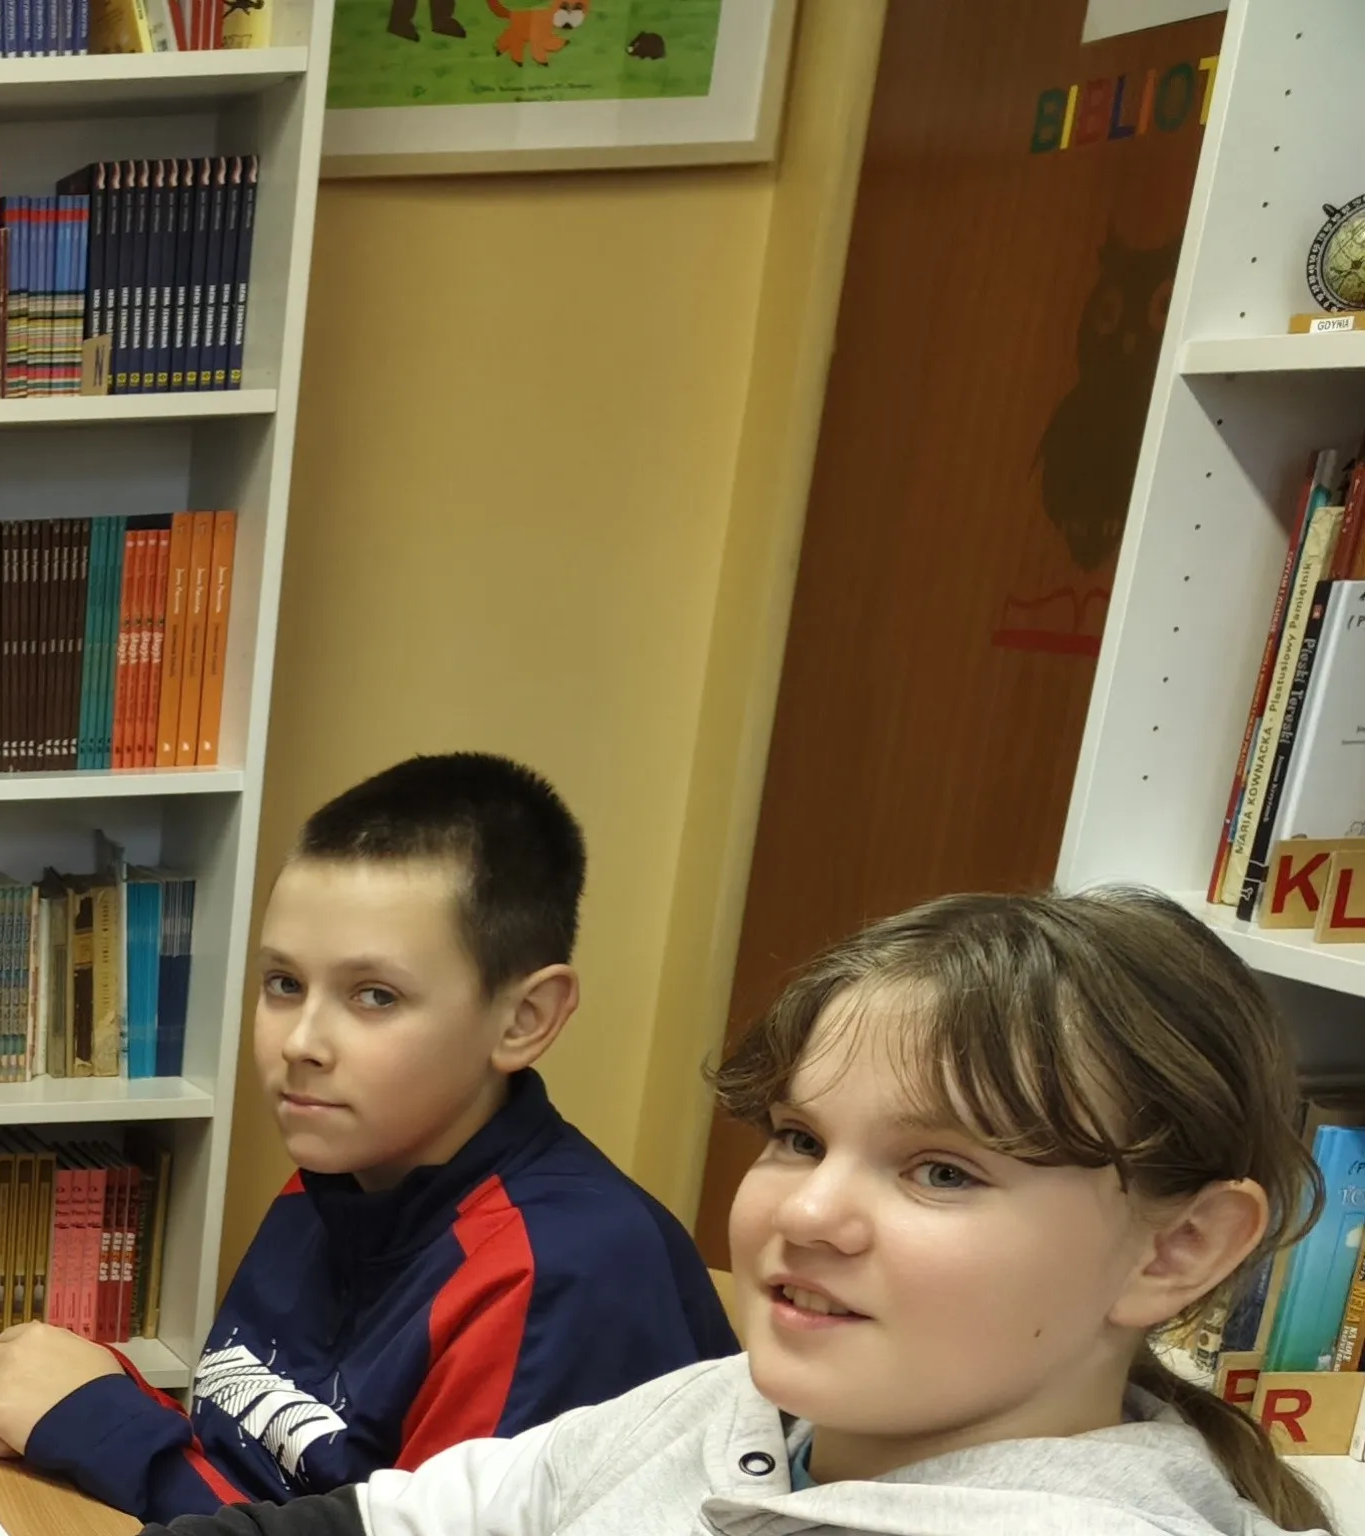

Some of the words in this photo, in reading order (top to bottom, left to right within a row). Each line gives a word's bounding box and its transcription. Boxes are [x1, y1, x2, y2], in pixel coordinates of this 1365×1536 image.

[1030, 54, 1219, 154] BIBLIOT
[1298, 636, 1317, 686] Pieski
[1235, 805, 1253, 855] MARIA
[1245, 725, 1274, 802] KOWNACKA
[1268, 626, 1296, 713] Plastusiowy
[1289, 560, 1314, 624] Pamiętnik
[1279, 688, 1307, 746] Tereski
[1270, 852, 1330, 915] K
[1329, 868, 1365, 929] L
[1260, 1388, 1312, 1443] R
